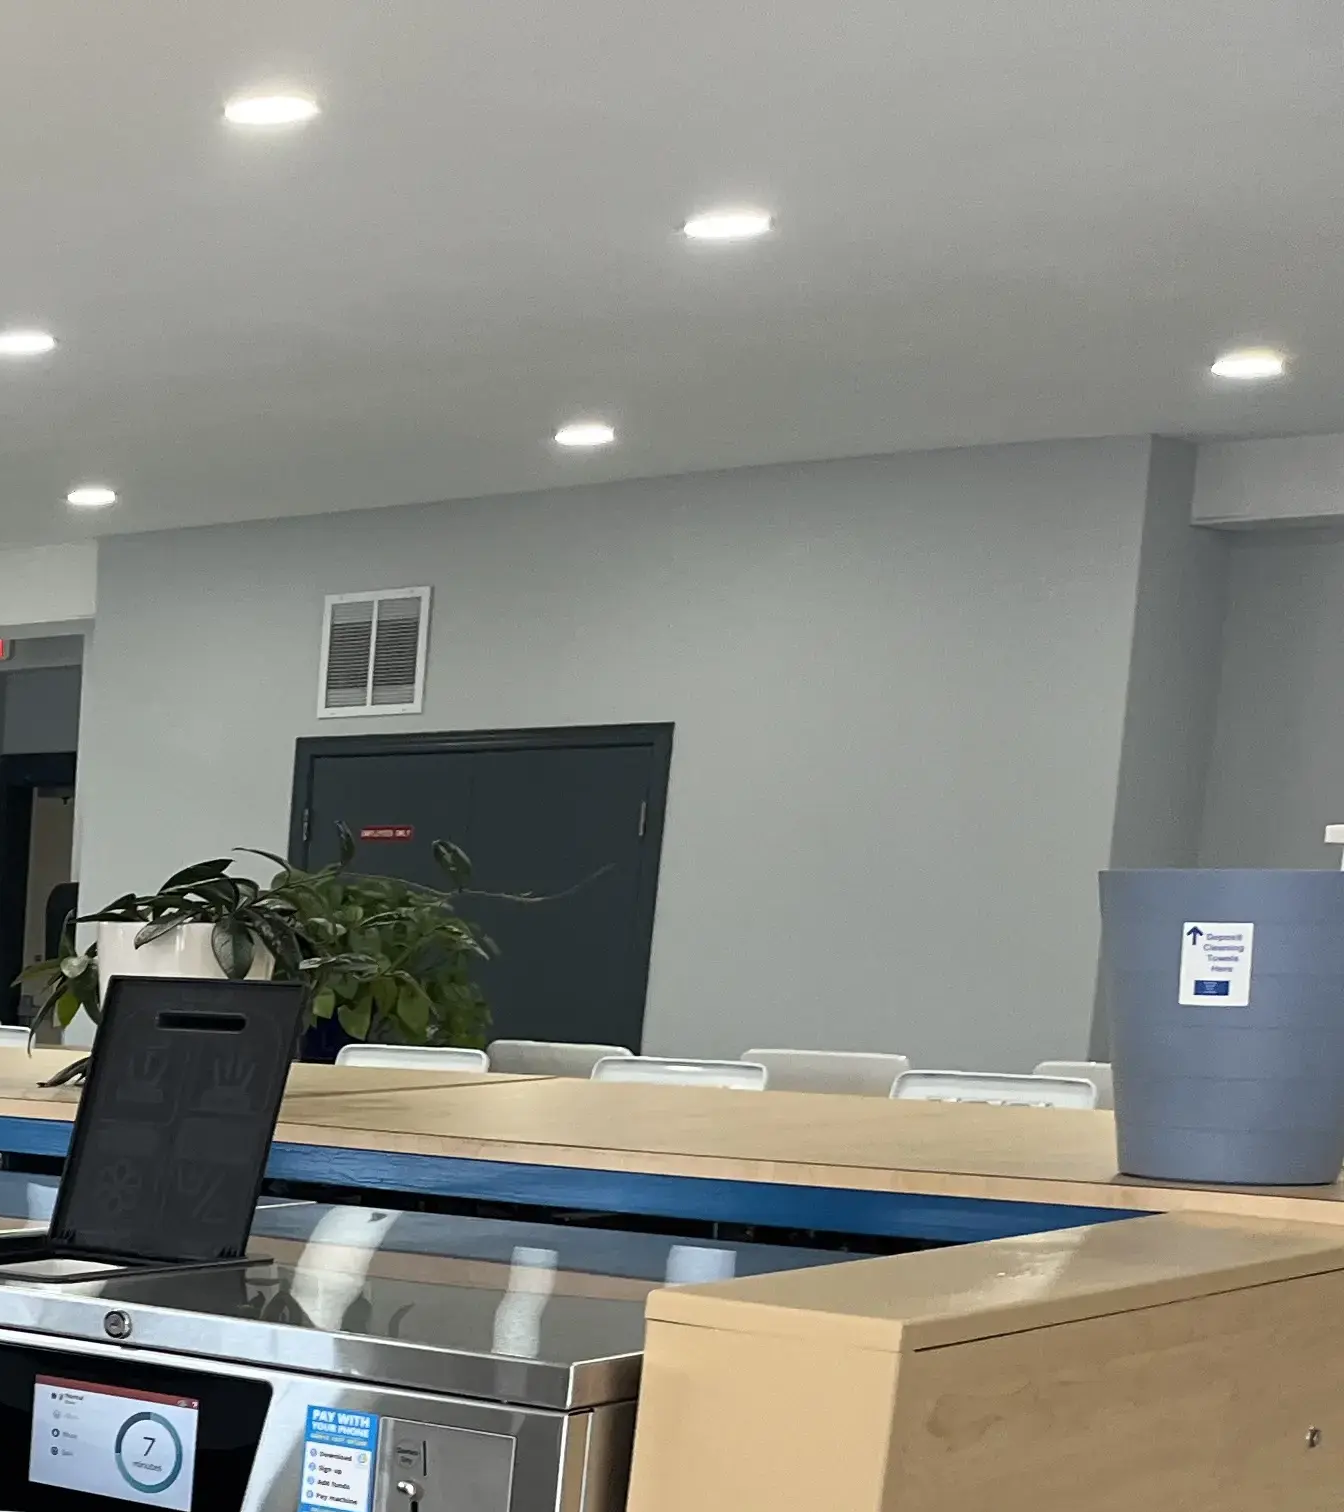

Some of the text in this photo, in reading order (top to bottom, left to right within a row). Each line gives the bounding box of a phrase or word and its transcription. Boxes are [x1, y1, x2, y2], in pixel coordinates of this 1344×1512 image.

[1206, 933, 1242, 941] Deposit
[1203, 944, 1244, 953] Cleaning
[1207, 954, 1238, 962] Towels
[312, 1409, 371, 1428] PAY WITH
[312, 1421, 370, 1438] YOUR PHONE
[143, 1436, 156, 1457] 7
[319, 1450, 353, 1462] Download
[132, 1460, 163, 1472] minutes
[318, 1465, 332, 1474] Sign
[317, 1478, 351, 1490] Add funds
[315, 1492, 358, 1505] Pay machine
